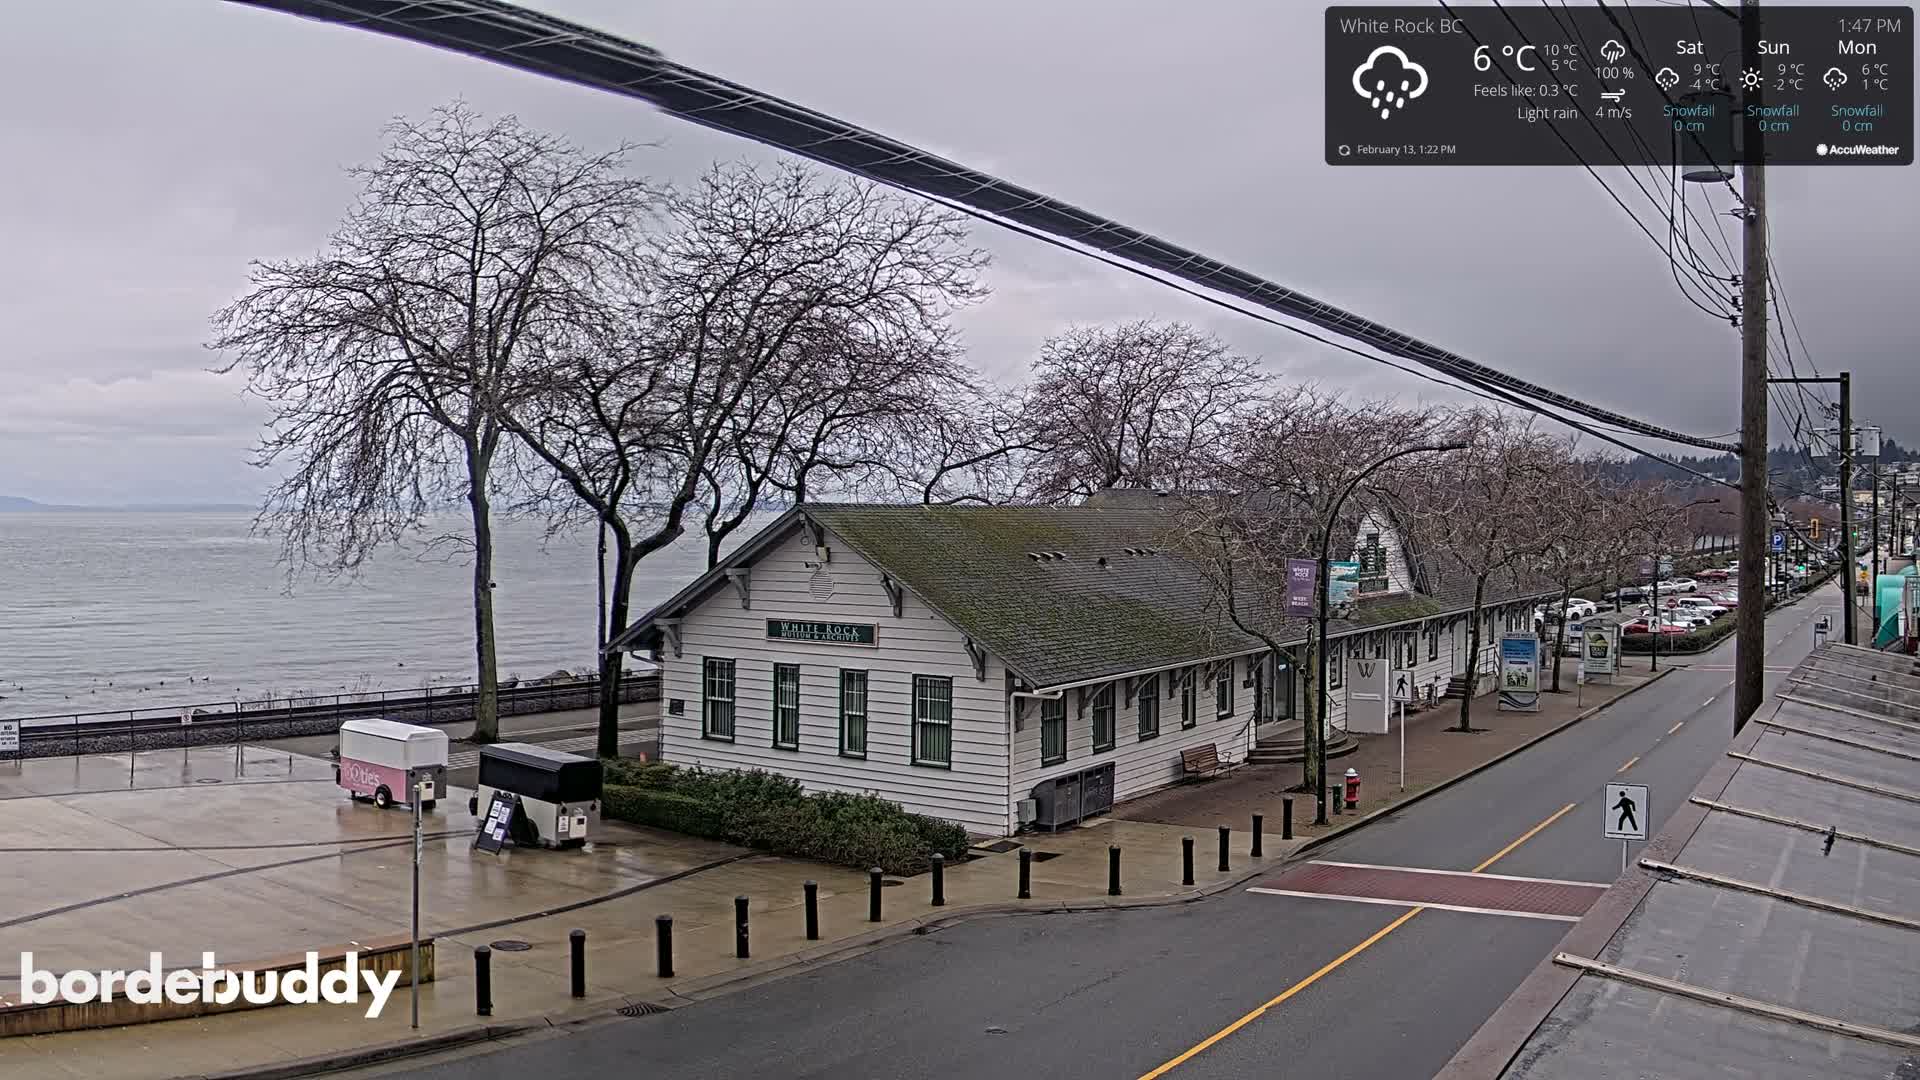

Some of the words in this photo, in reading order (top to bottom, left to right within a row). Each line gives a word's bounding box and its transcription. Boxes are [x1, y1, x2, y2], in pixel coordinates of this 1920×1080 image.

[780, 622, 819, 632] WHITE
[826, 624, 860, 637] ROCK
[780, 631, 811, 639] MUSEUM
